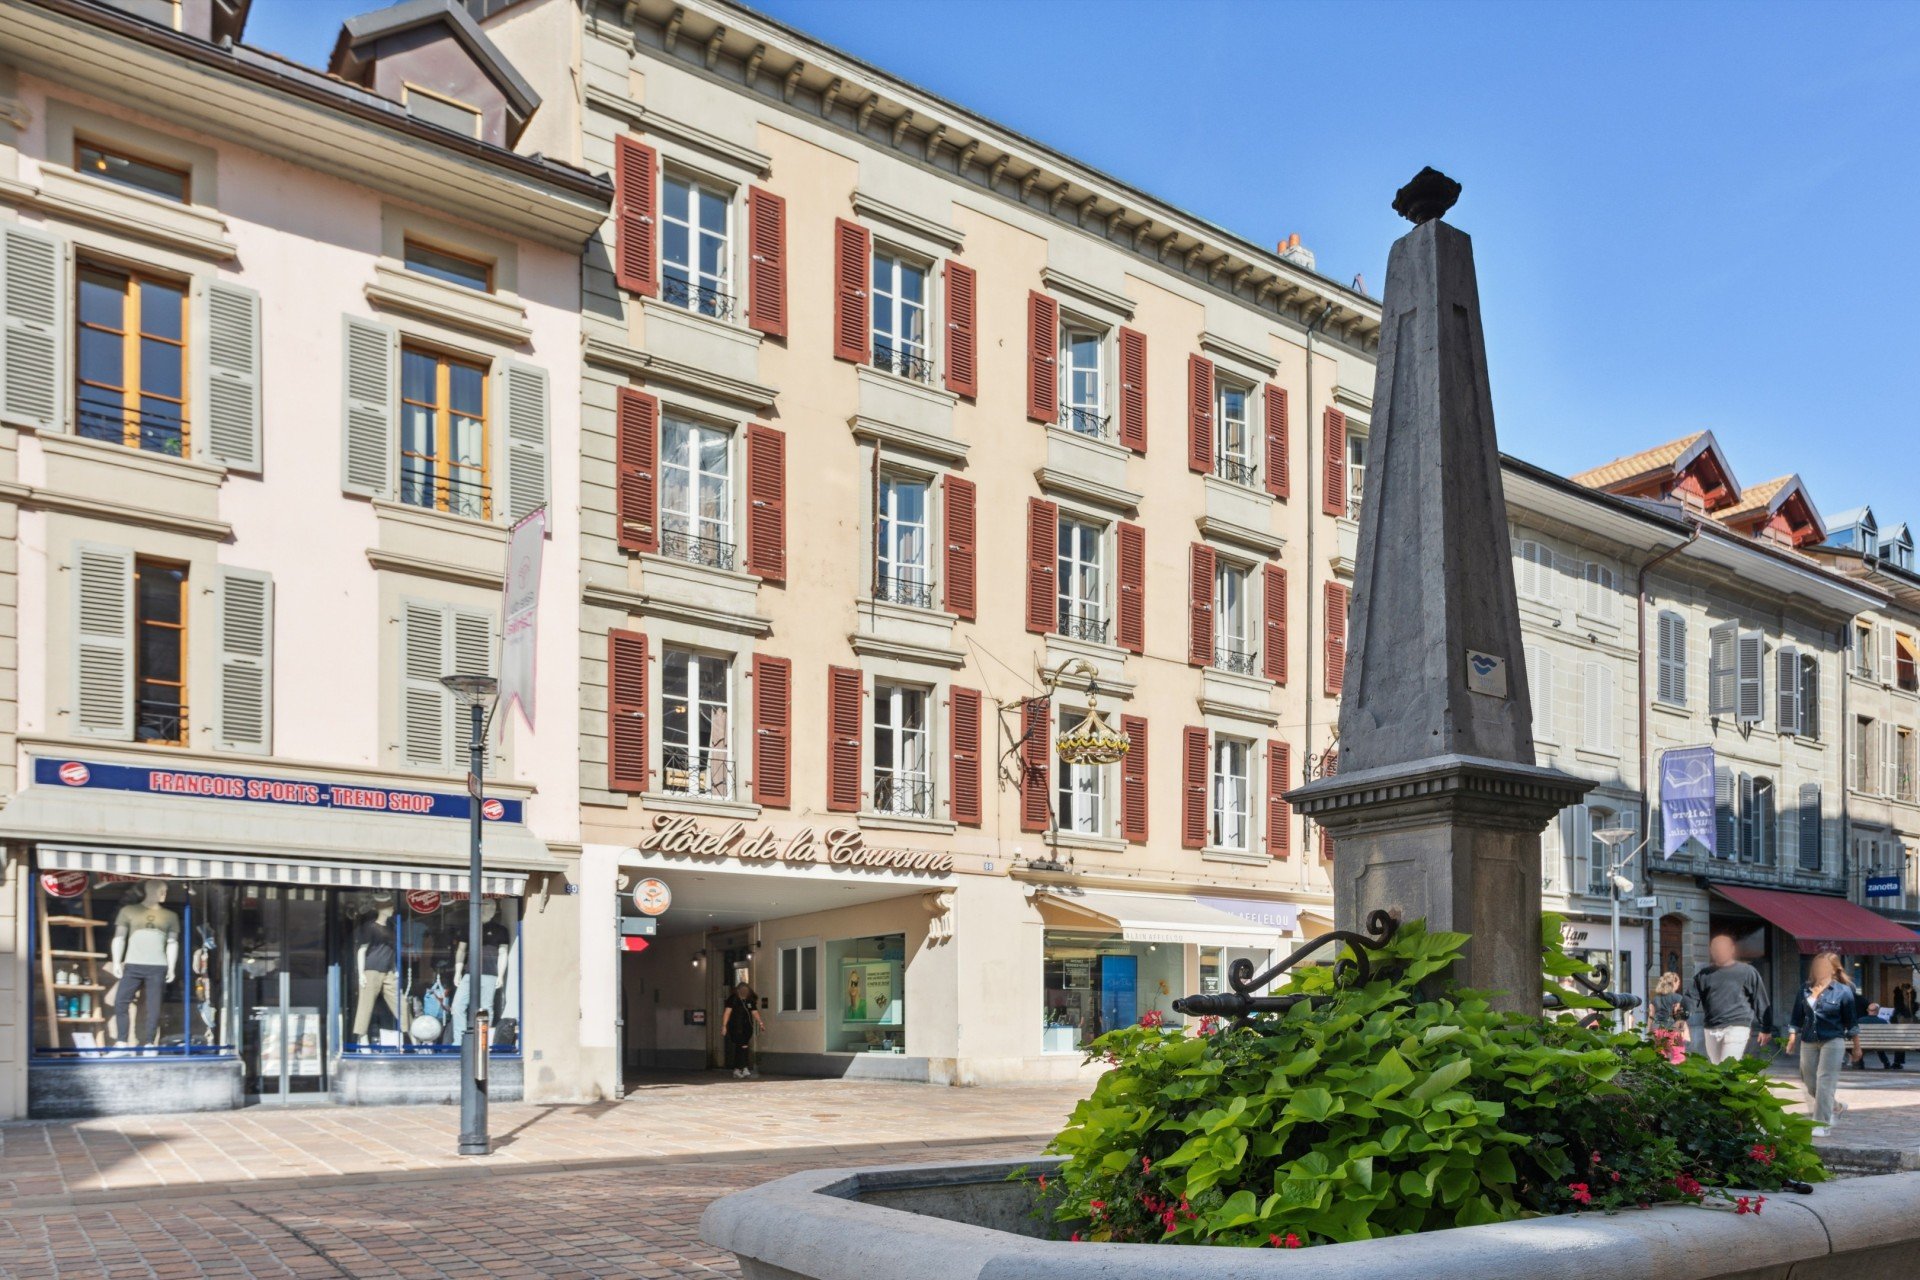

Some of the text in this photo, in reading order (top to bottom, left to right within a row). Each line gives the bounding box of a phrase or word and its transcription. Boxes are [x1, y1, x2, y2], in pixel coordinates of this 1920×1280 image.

[150, 771, 246, 798] FRANCOIS
[247, 779, 319, 804] SPORTS
[331, 787, 386, 809] TREND
[388, 792, 434, 813] SHOP
[640, 814, 954, 871] Hôtel de la Couronne
[984, 862, 993, 871] 88
[566, 884, 578, 893] 90
[1867, 882, 1898, 891] zanotta
[1239, 912, 1289, 926] AFFLELOU
[1125, 932, 1183, 942] ALAIN AFFLELOU
